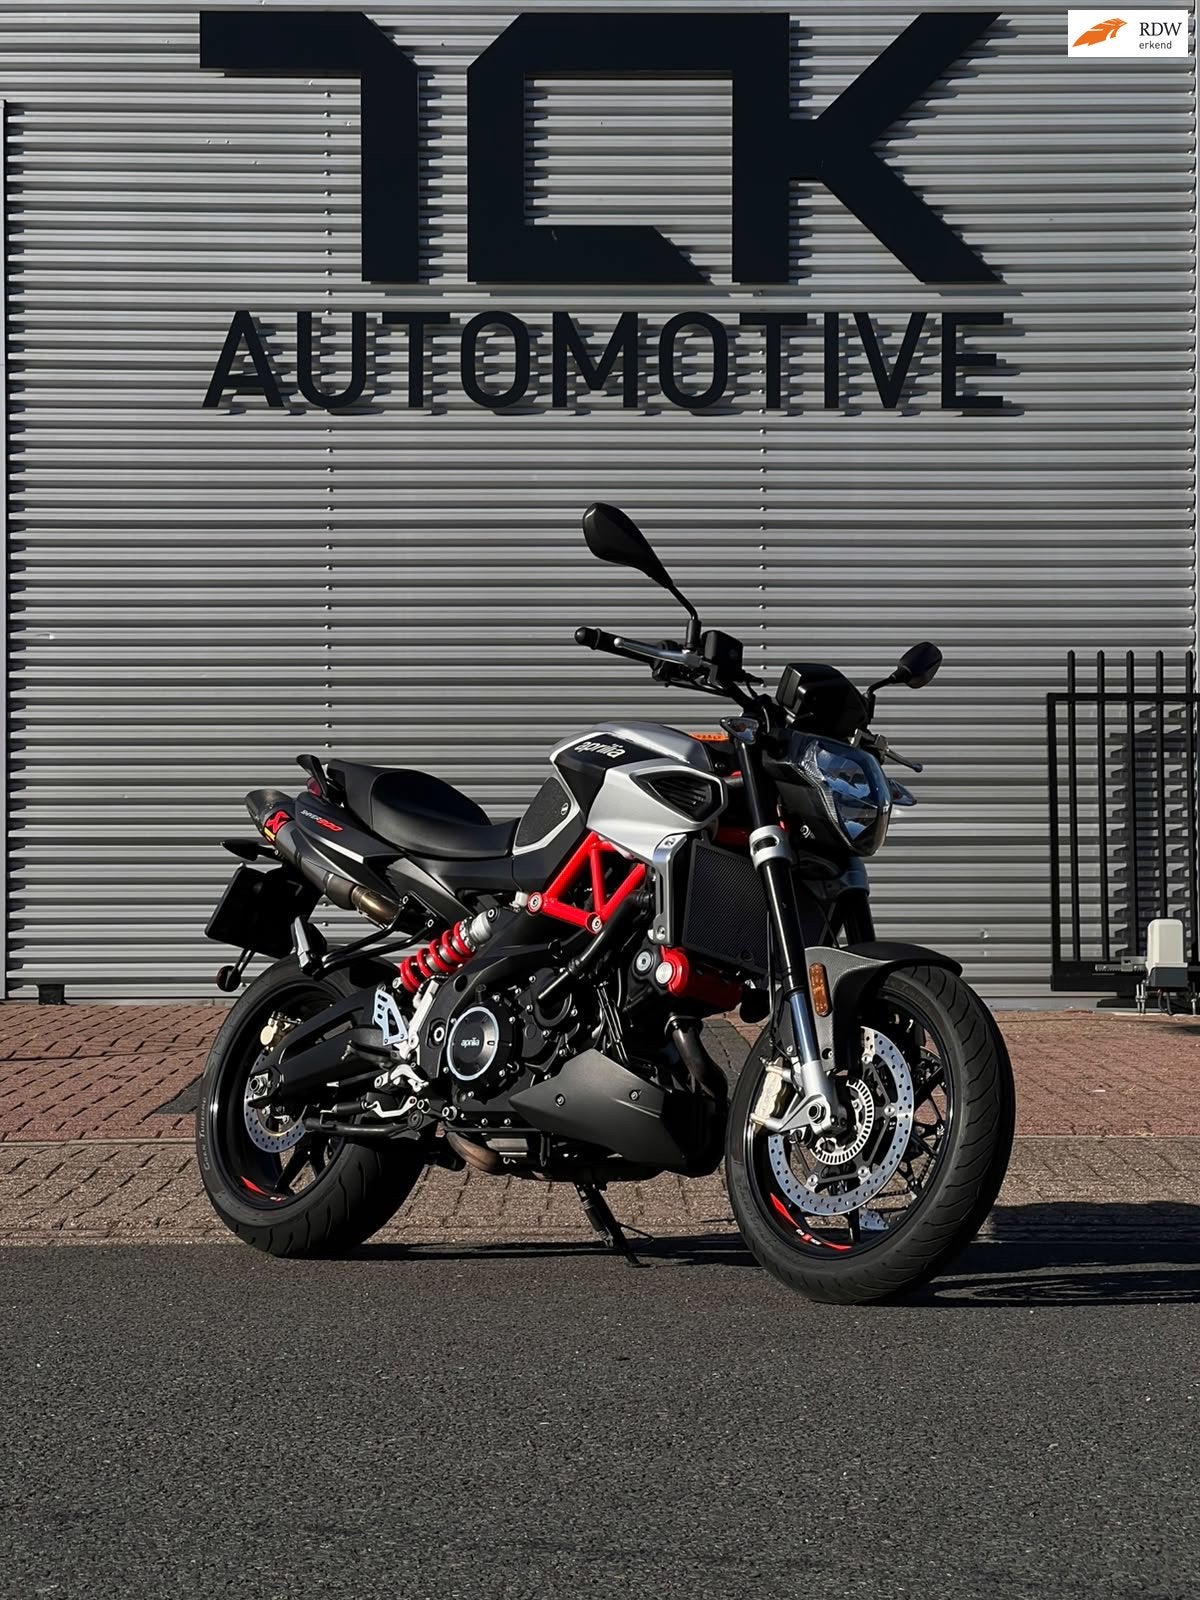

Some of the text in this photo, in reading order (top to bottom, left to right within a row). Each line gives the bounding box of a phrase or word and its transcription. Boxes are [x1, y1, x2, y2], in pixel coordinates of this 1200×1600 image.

[200, 11, 1001, 283] TCK
[204, 310, 1004, 409] AUTOMOTIVE
[574, 741, 626, 758] aprilia
